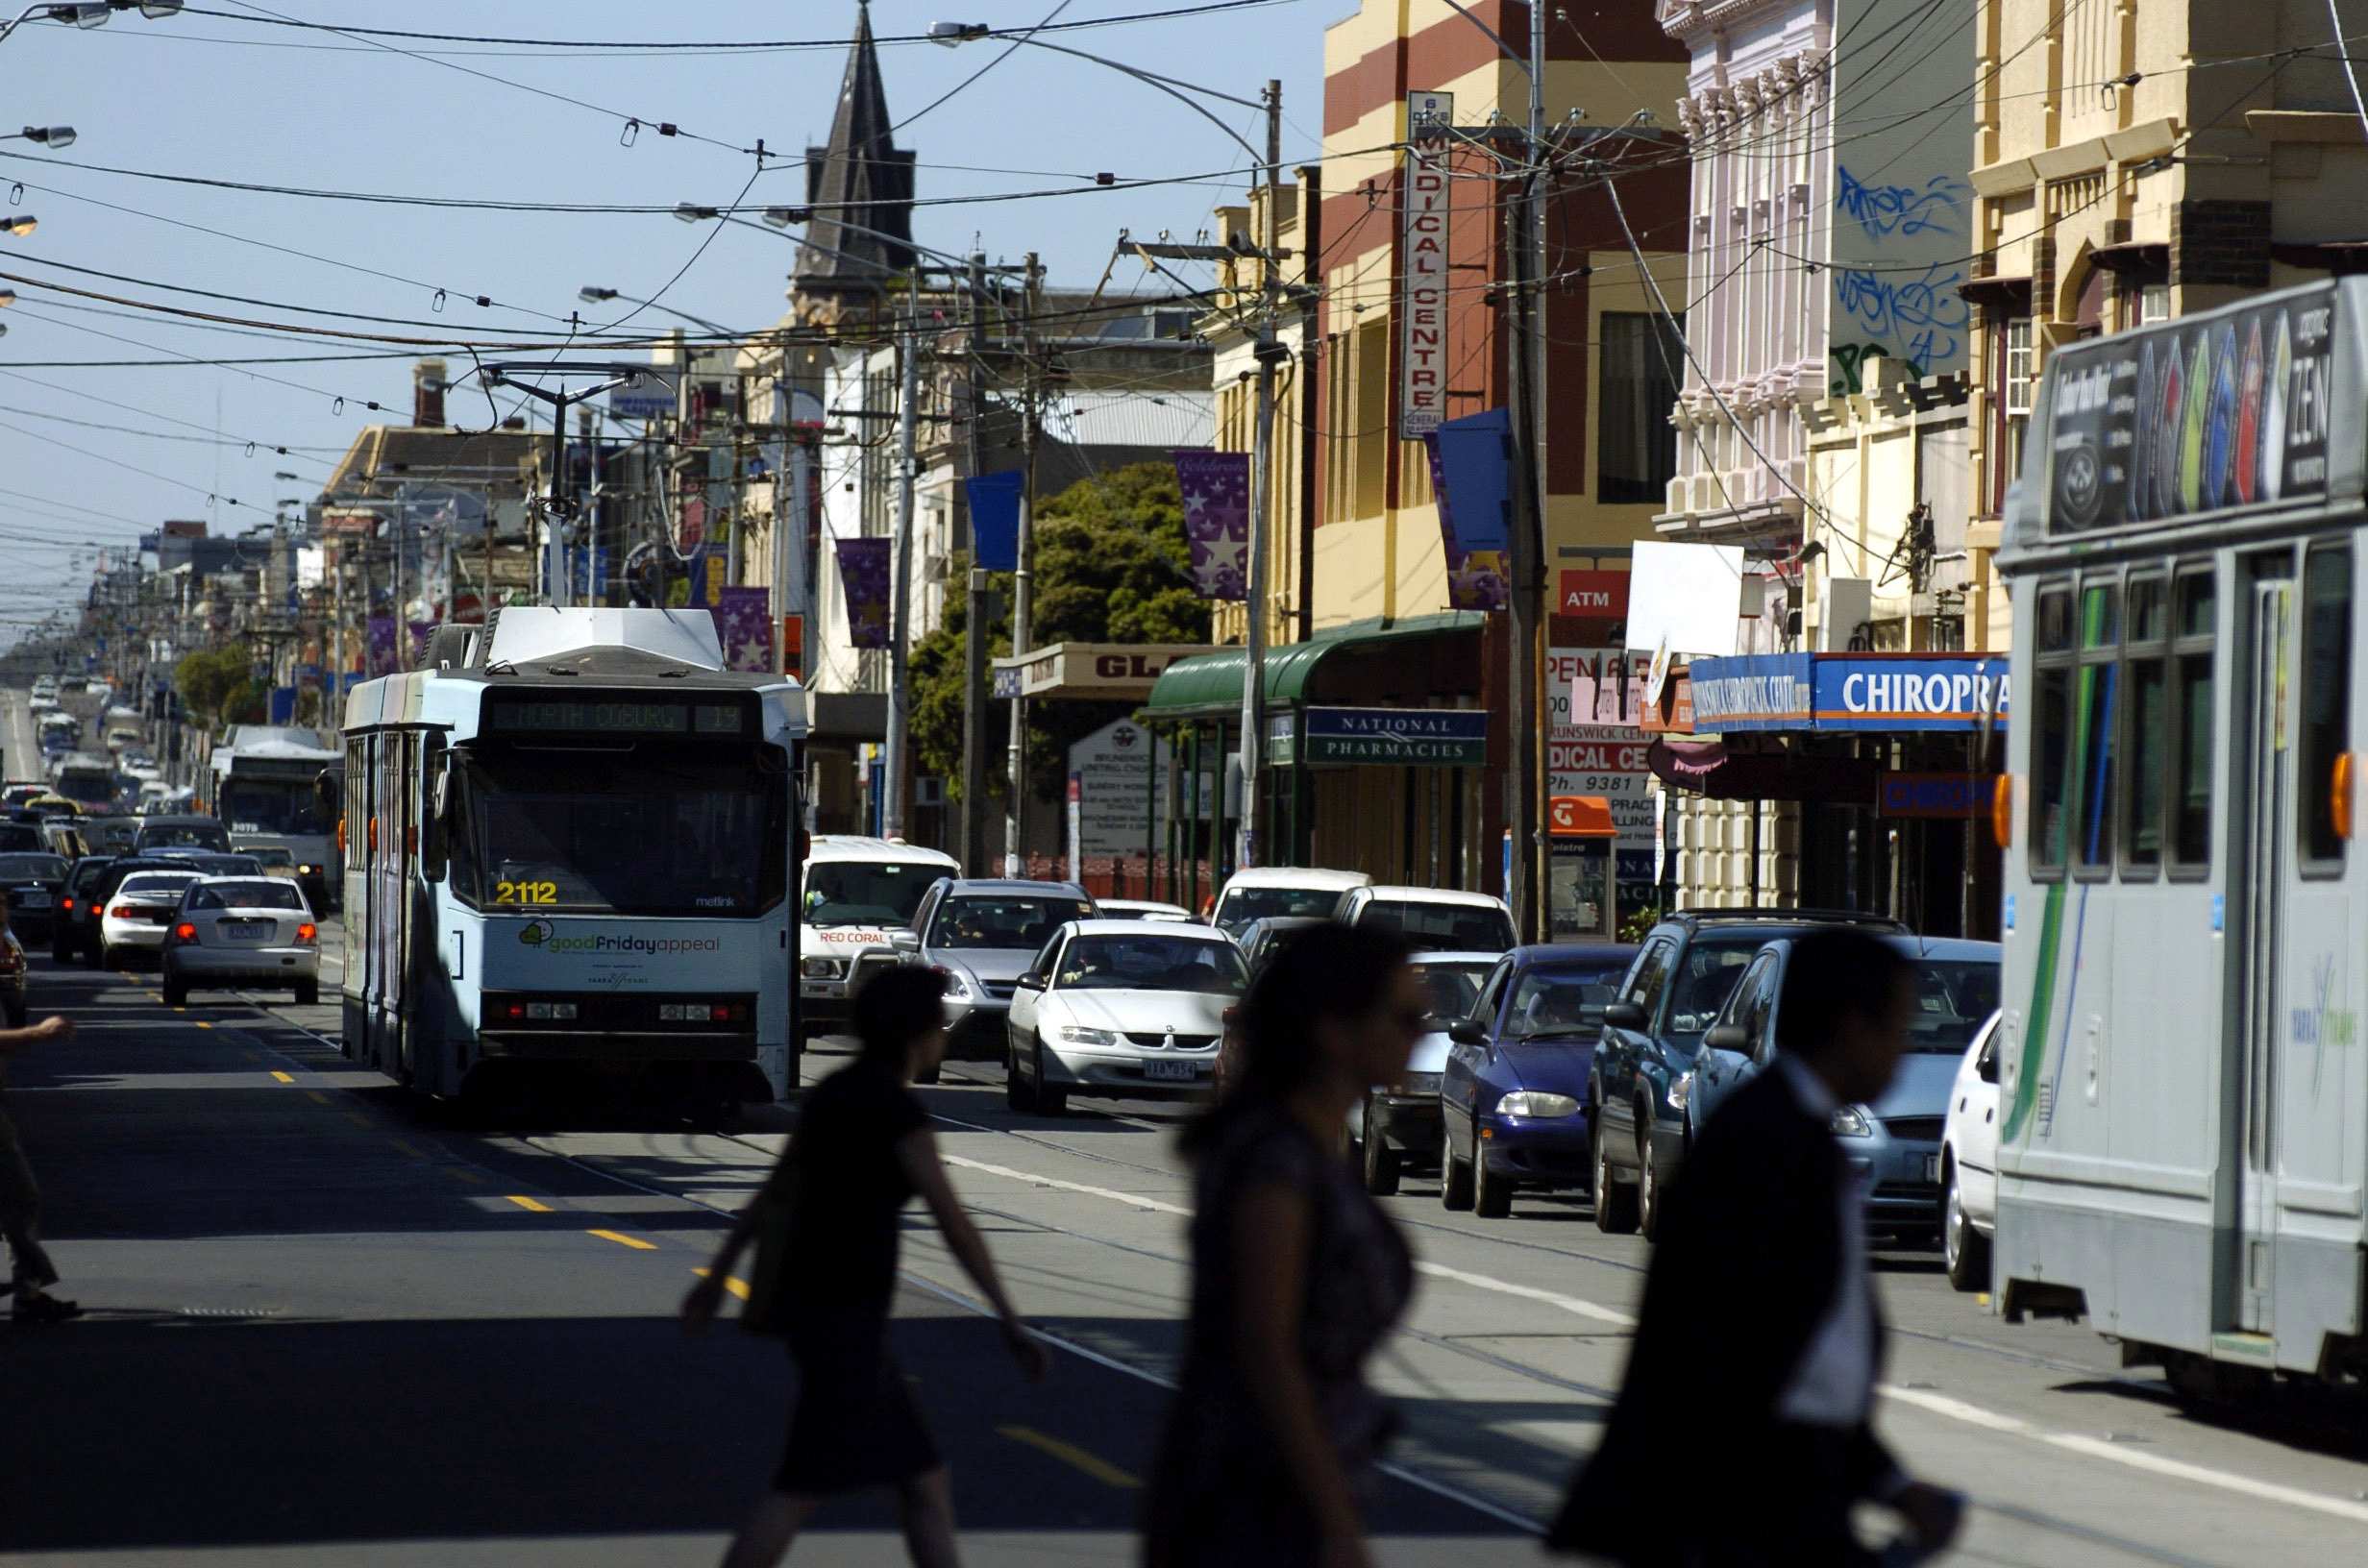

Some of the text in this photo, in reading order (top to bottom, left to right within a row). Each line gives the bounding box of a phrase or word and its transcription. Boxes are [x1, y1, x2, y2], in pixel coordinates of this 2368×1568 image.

[1414, 137, 1445, 274] MEDICAL
[1412, 288, 1439, 406] CENTRE
[1566, 591, 1609, 607] ATM
[1096, 654, 1185, 678] GL
[598, 705, 676, 729] COBURG
[1342, 718, 1450, 732] NATIONAL
[1551, 726, 1656, 740] RUNSWICK CENT
[1326, 742, 1464, 757] PHARMACIES
[1550, 746, 1650, 770] DICAL CE
[1586, 776, 1631, 792] 9381
[497, 882, 557, 904] 2112
[696, 896, 735, 907] metlink
[821, 932, 885, 943] RED CORAL
